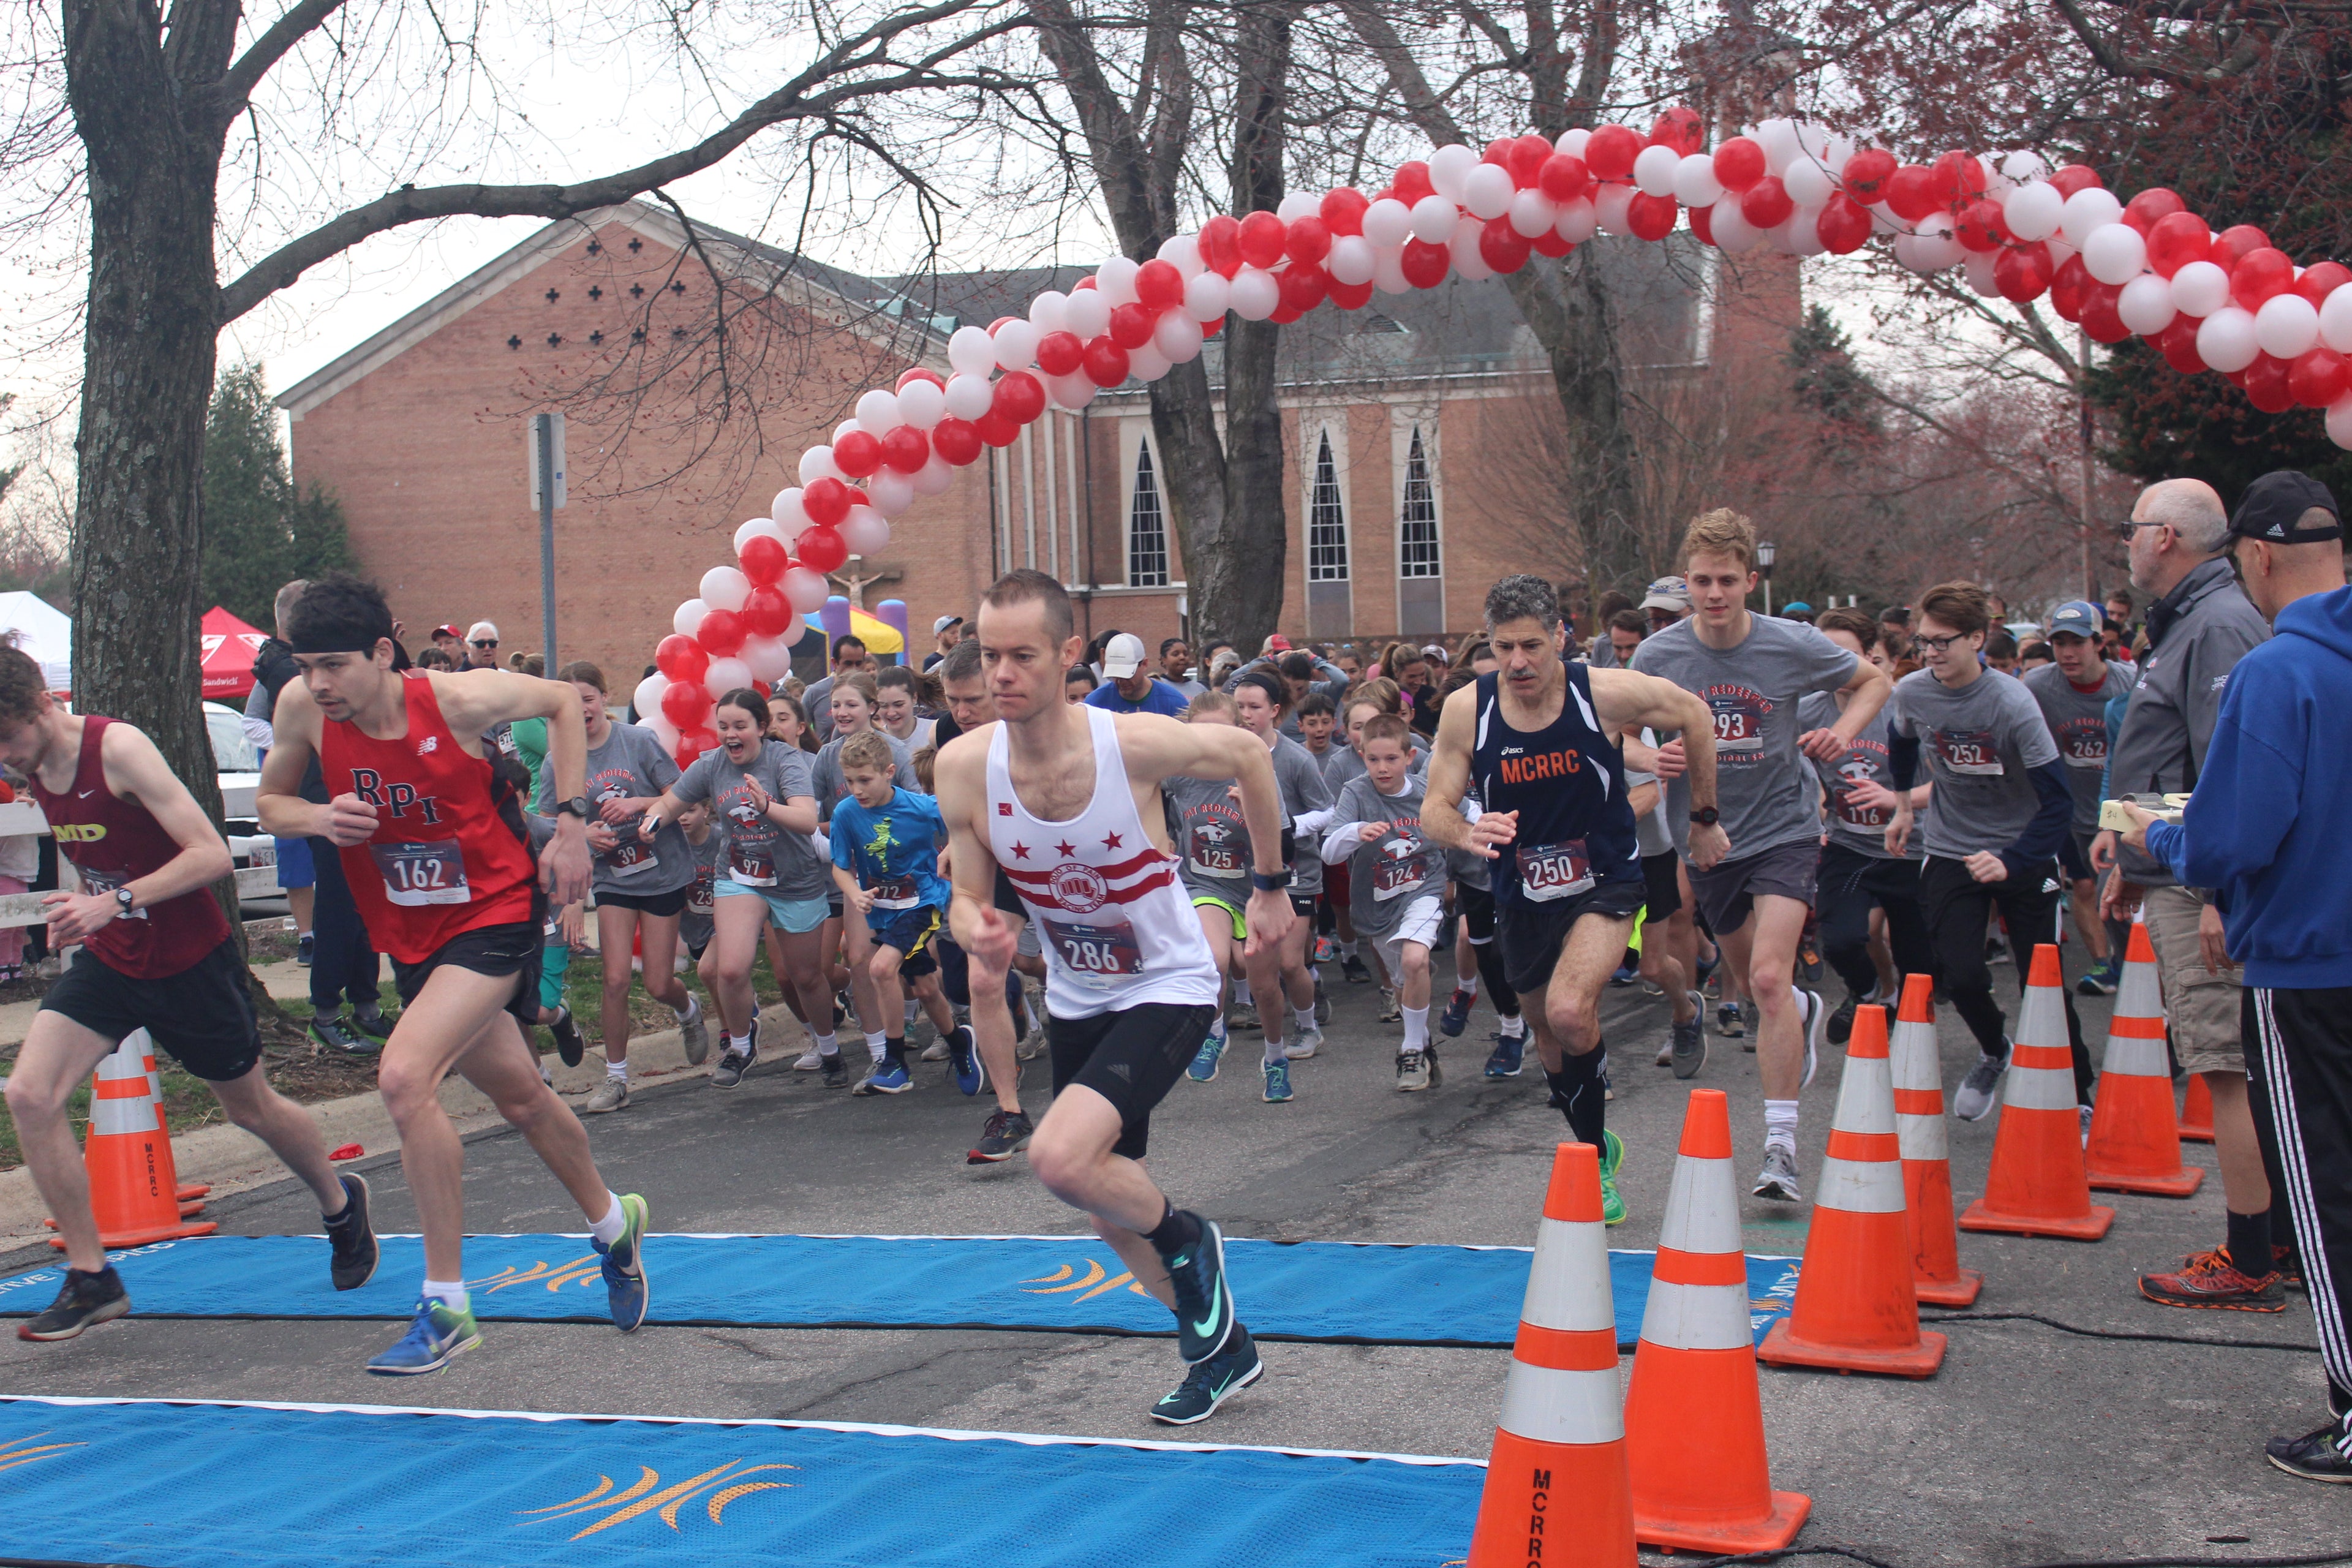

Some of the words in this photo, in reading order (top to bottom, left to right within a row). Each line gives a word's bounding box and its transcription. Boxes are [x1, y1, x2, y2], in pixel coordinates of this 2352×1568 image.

[1948, 745, 1986, 763] 252
[2073, 742, 2104, 757] 262
[1501, 749, 1580, 784] MCRRC
[350, 768, 443, 824] RPI
[1849, 807, 1879, 824] 116
[618, 846, 636, 865] 39
[1202, 849, 1232, 868] 125
[393, 859, 446, 888] 162
[743, 859, 760, 876] 97
[1387, 865, 1414, 888] 124
[1529, 856, 1574, 887] 250
[696, 891, 713, 905] 23
[880, 886, 901, 899] 72
[1064, 940, 1120, 971] 286
[145, 1143, 158, 1197] MCRRC
